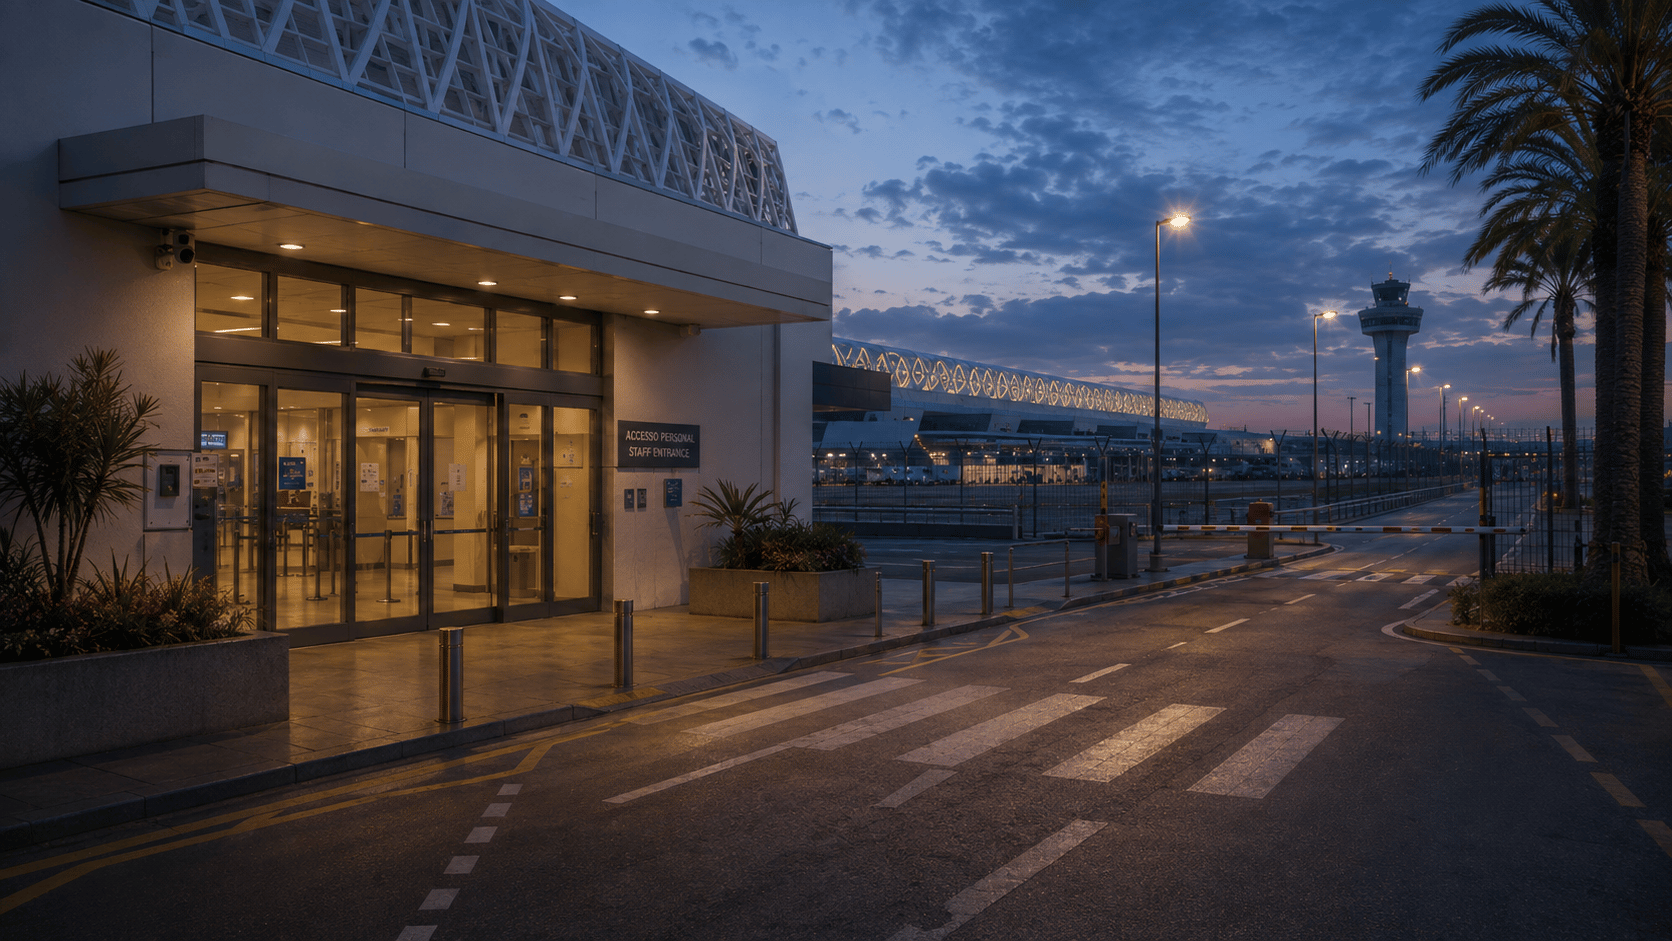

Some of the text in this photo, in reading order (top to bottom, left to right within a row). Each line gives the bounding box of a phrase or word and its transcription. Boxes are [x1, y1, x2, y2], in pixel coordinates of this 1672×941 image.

[625, 430, 695, 443] ACCESSO PERSONAL
[628, 446, 690, 458] STAFF ENTRANCE
